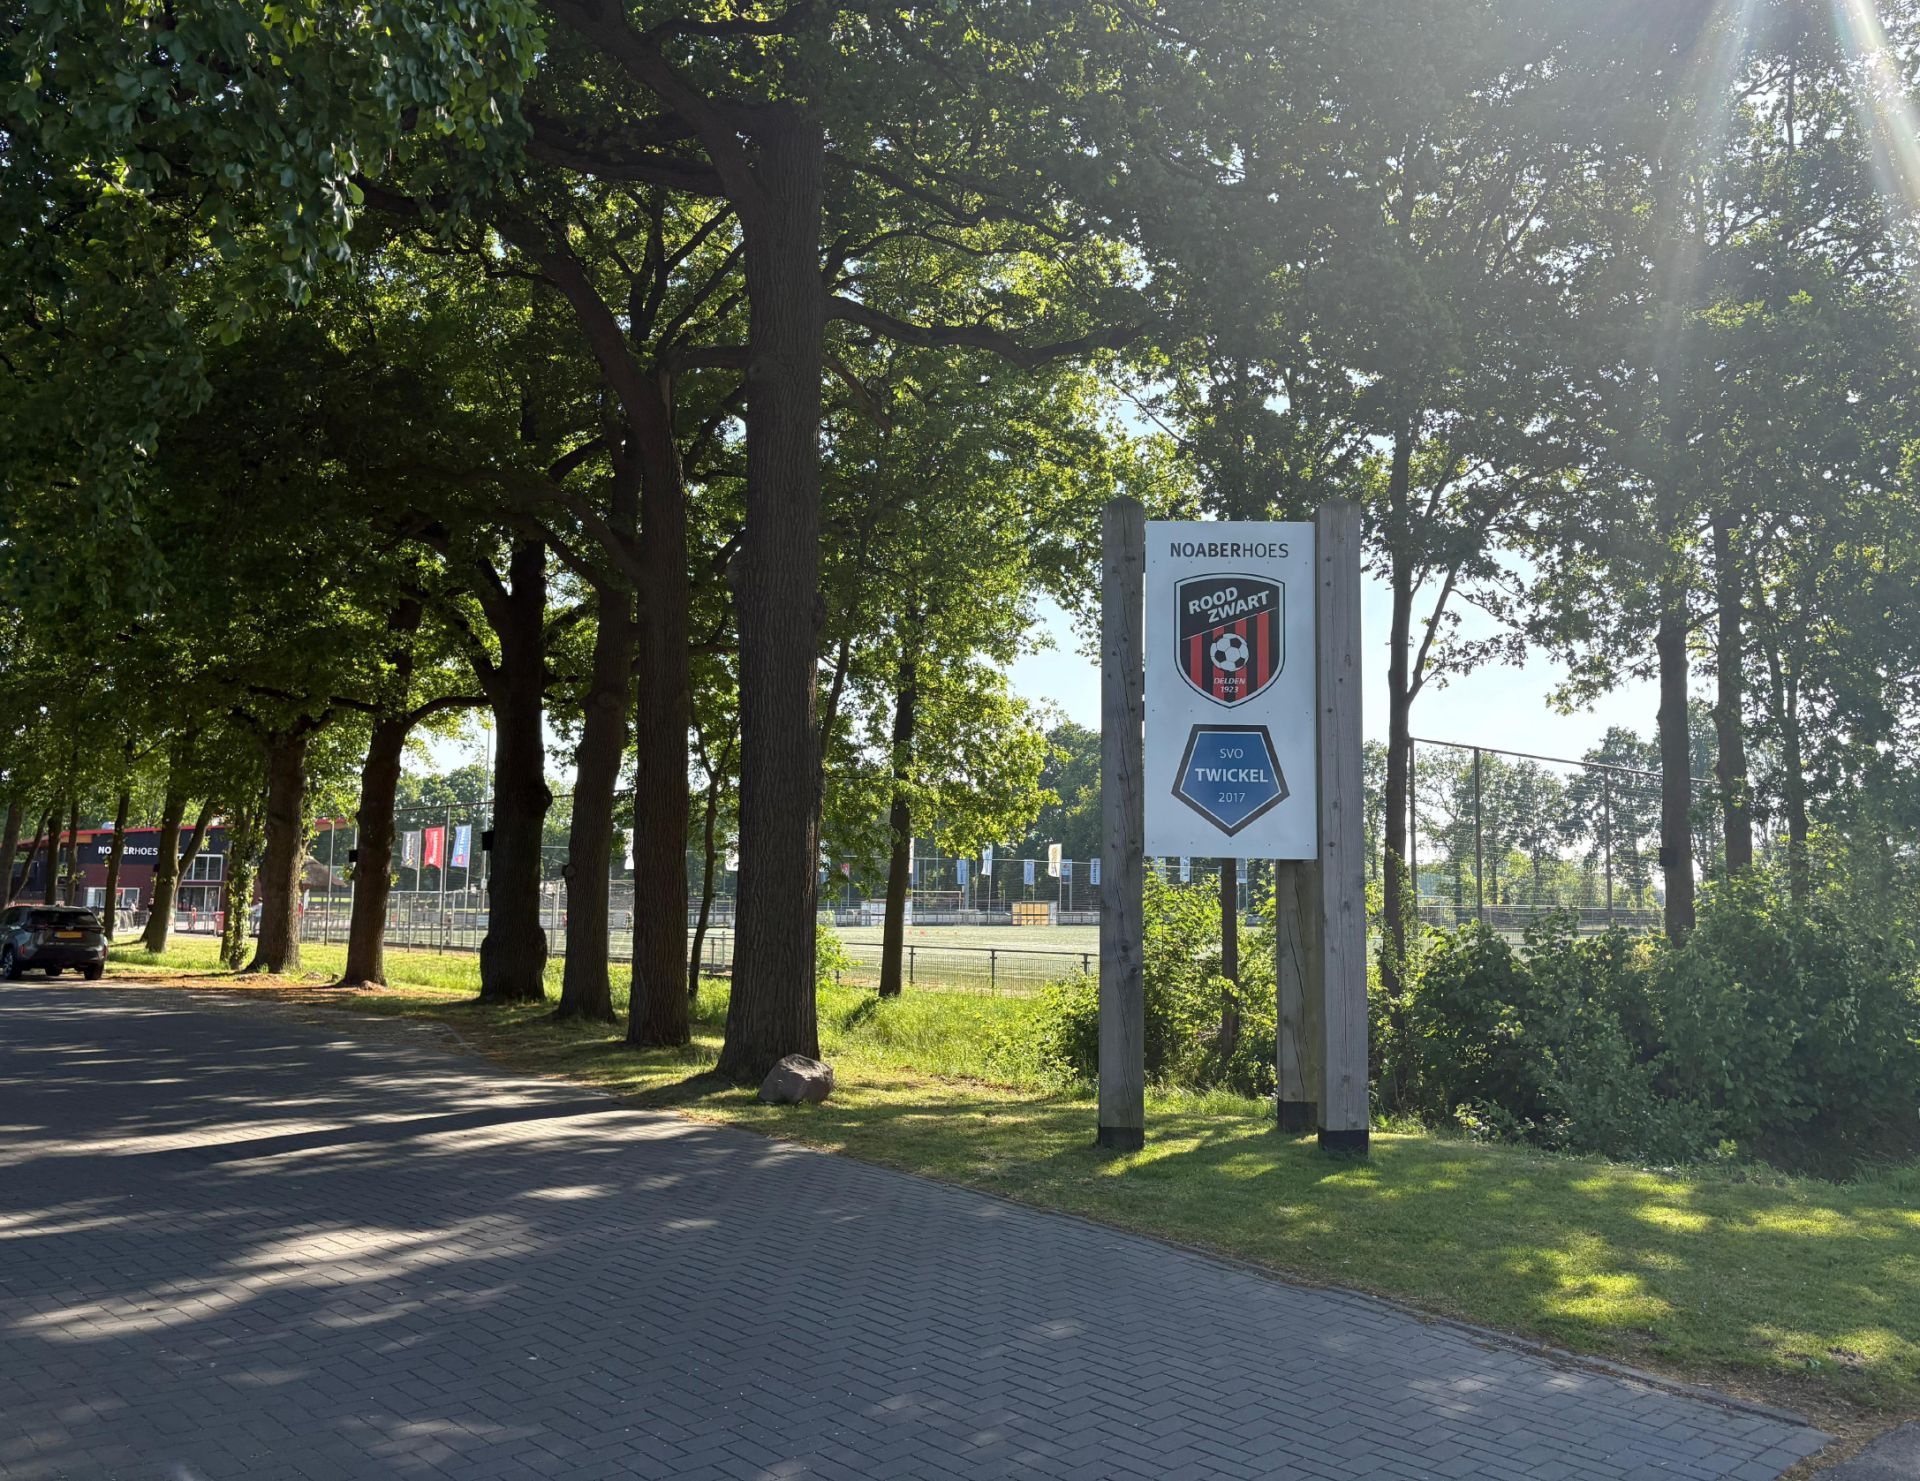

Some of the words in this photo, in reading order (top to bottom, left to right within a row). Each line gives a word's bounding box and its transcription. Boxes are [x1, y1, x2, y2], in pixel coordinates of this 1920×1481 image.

[1169, 542, 1289, 558] NOABERHOES
[1188, 586, 1238, 615] ROOD
[1207, 590, 1270, 623] ZWART
[1213, 677, 1246, 685] DELDEN
[1219, 748, 1243, 759] SVO
[1195, 768, 1268, 782] TWICKEL
[1218, 792, 1245, 803] 2017
[97, 846, 158, 856] NOERHOES
